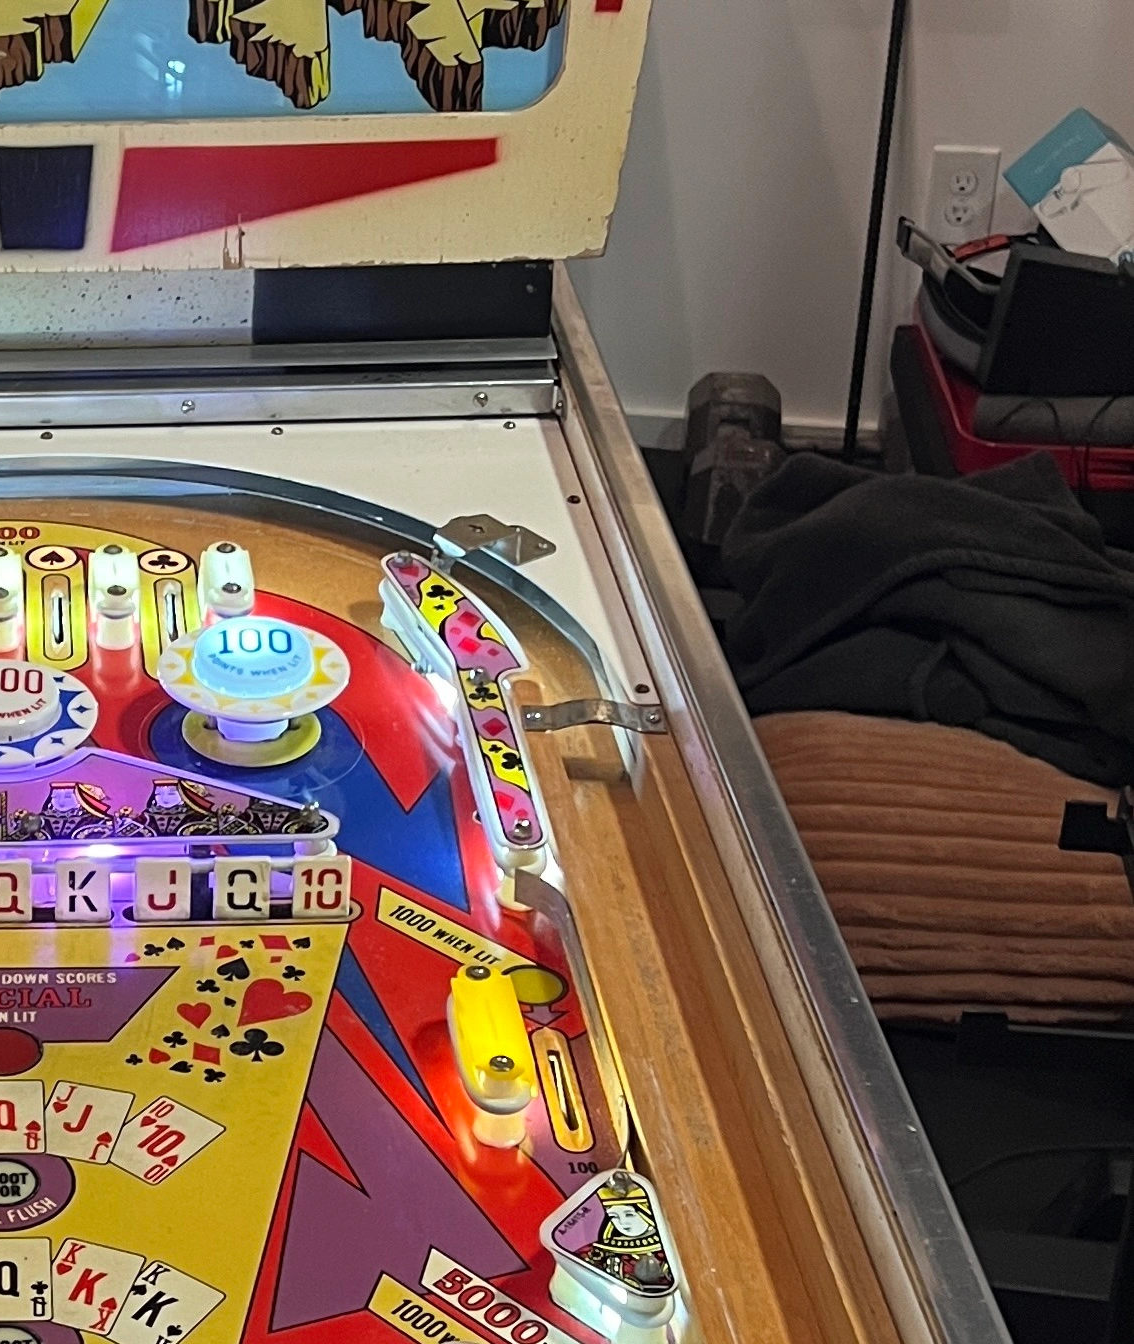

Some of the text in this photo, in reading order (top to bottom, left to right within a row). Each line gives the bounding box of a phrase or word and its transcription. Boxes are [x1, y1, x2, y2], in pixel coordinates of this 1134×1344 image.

[218, 629, 292, 654] 100
[250, 667, 288, 676] WHEN
[31, 698, 46, 713] LIT
[68, 870, 97, 912] K
[148, 870, 176, 911] J
[227, 870, 261, 911] Q
[301, 869, 342, 909] 10
[389, 904, 502, 966] 1000 WHEN LIT
[2, 973, 48, 984] DOWN
[56, 973, 116, 983] SCORES
[14, 1011, 37, 1022] LIT
[568, 1162, 598, 1174] 100
[7, 1197, 57, 1221] FLUSH
[390, 1298, 447, 1338] 1000
